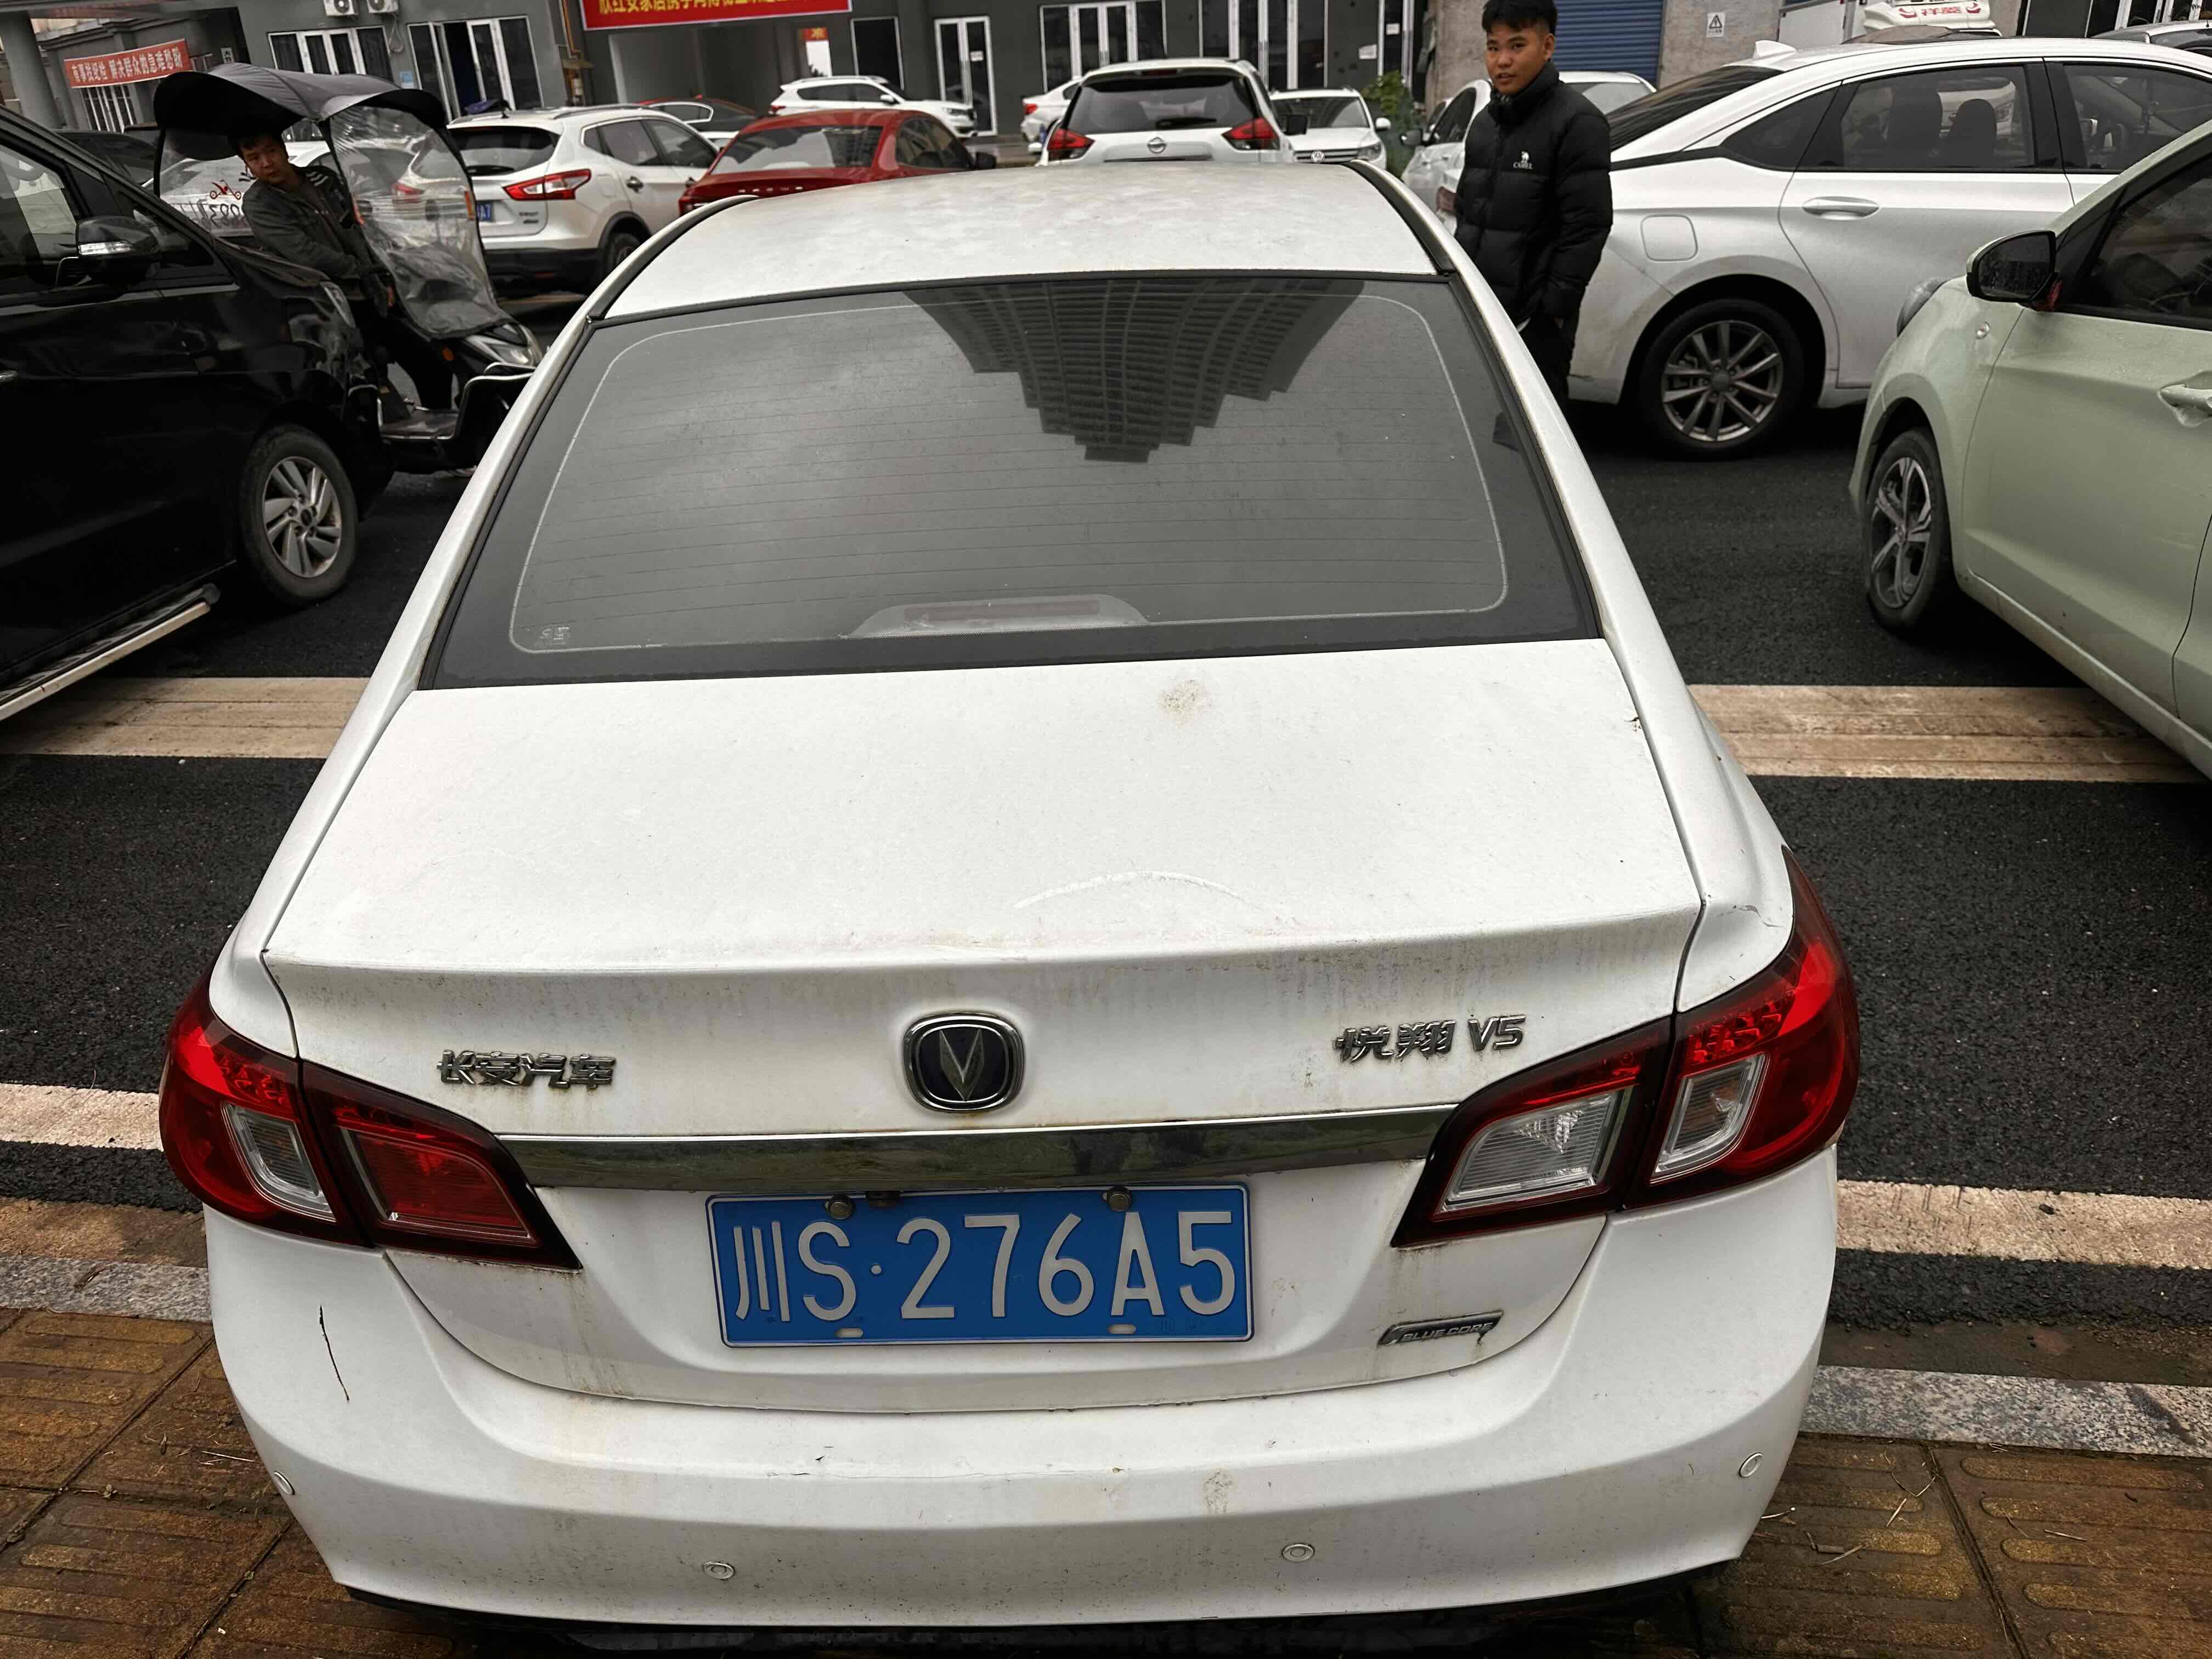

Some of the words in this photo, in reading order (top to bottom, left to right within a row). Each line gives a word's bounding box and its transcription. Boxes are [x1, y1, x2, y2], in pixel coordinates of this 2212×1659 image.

[1334, 1019, 1456, 1062] 悦翔
[1468, 1014, 1526, 1051] V5
[436, 1049, 616, 1090] 长安汽车
